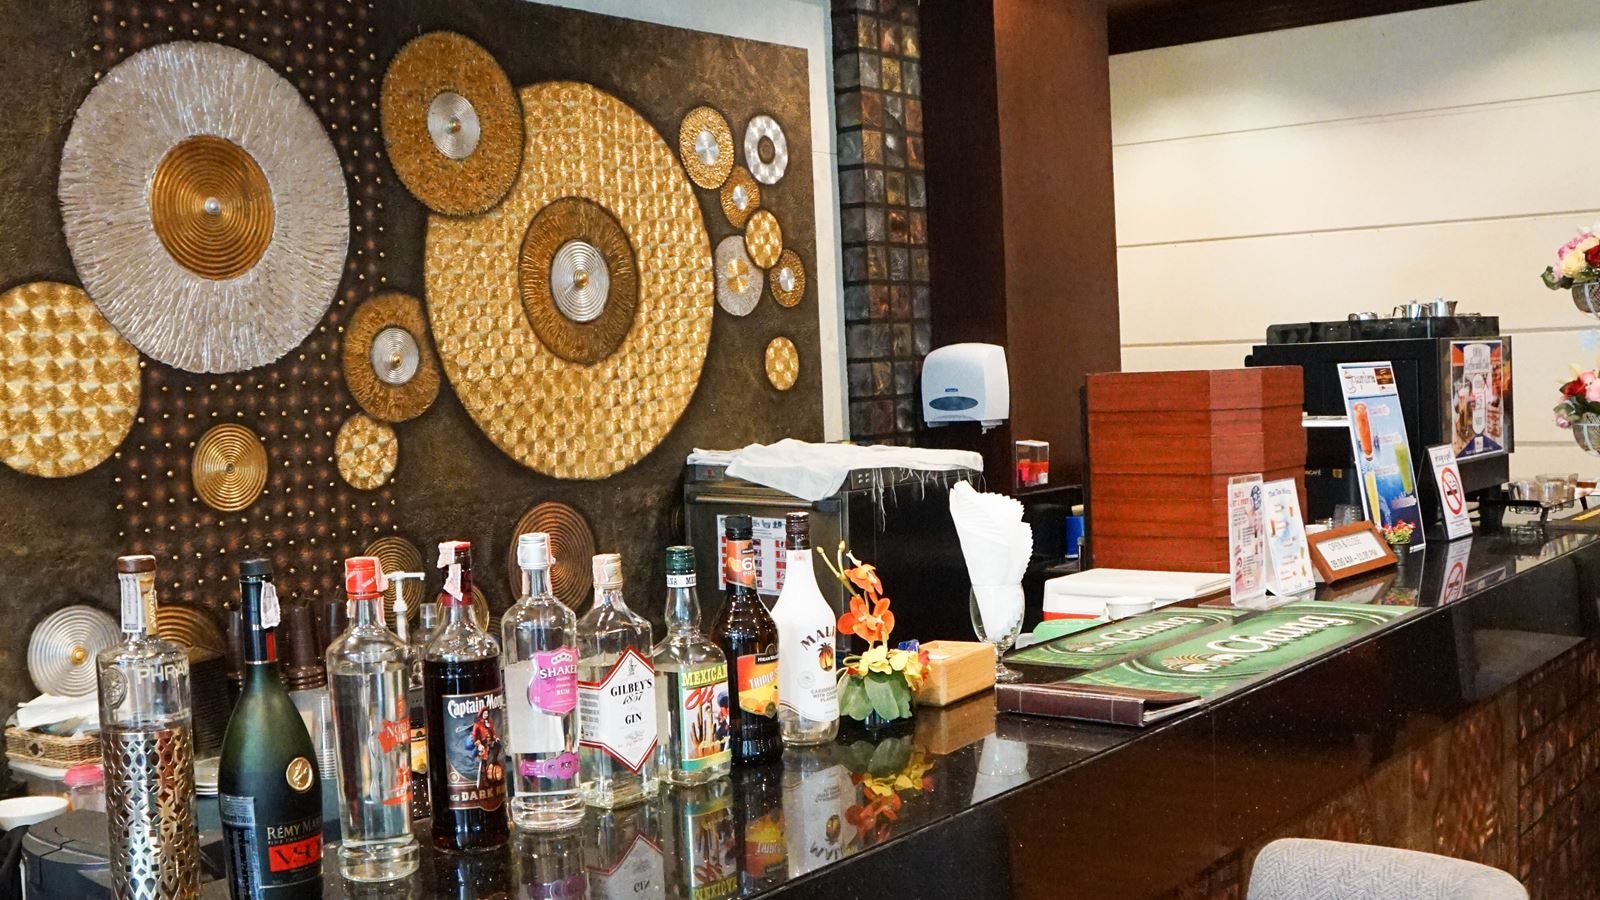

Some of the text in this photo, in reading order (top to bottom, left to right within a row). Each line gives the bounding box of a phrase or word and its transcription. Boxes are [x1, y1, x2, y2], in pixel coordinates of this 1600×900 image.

[1100, 615, 1204, 641] Chang
[1206, 614, 1354, 653] Chang
[611, 678, 653, 697] GILBEY'S
[622, 692, 643, 705] 1857
[447, 696, 484, 719] Captain
[625, 713, 642, 725] GIN
[461, 789, 494, 801] DARK
[266, 825, 300, 841] RÉMY
